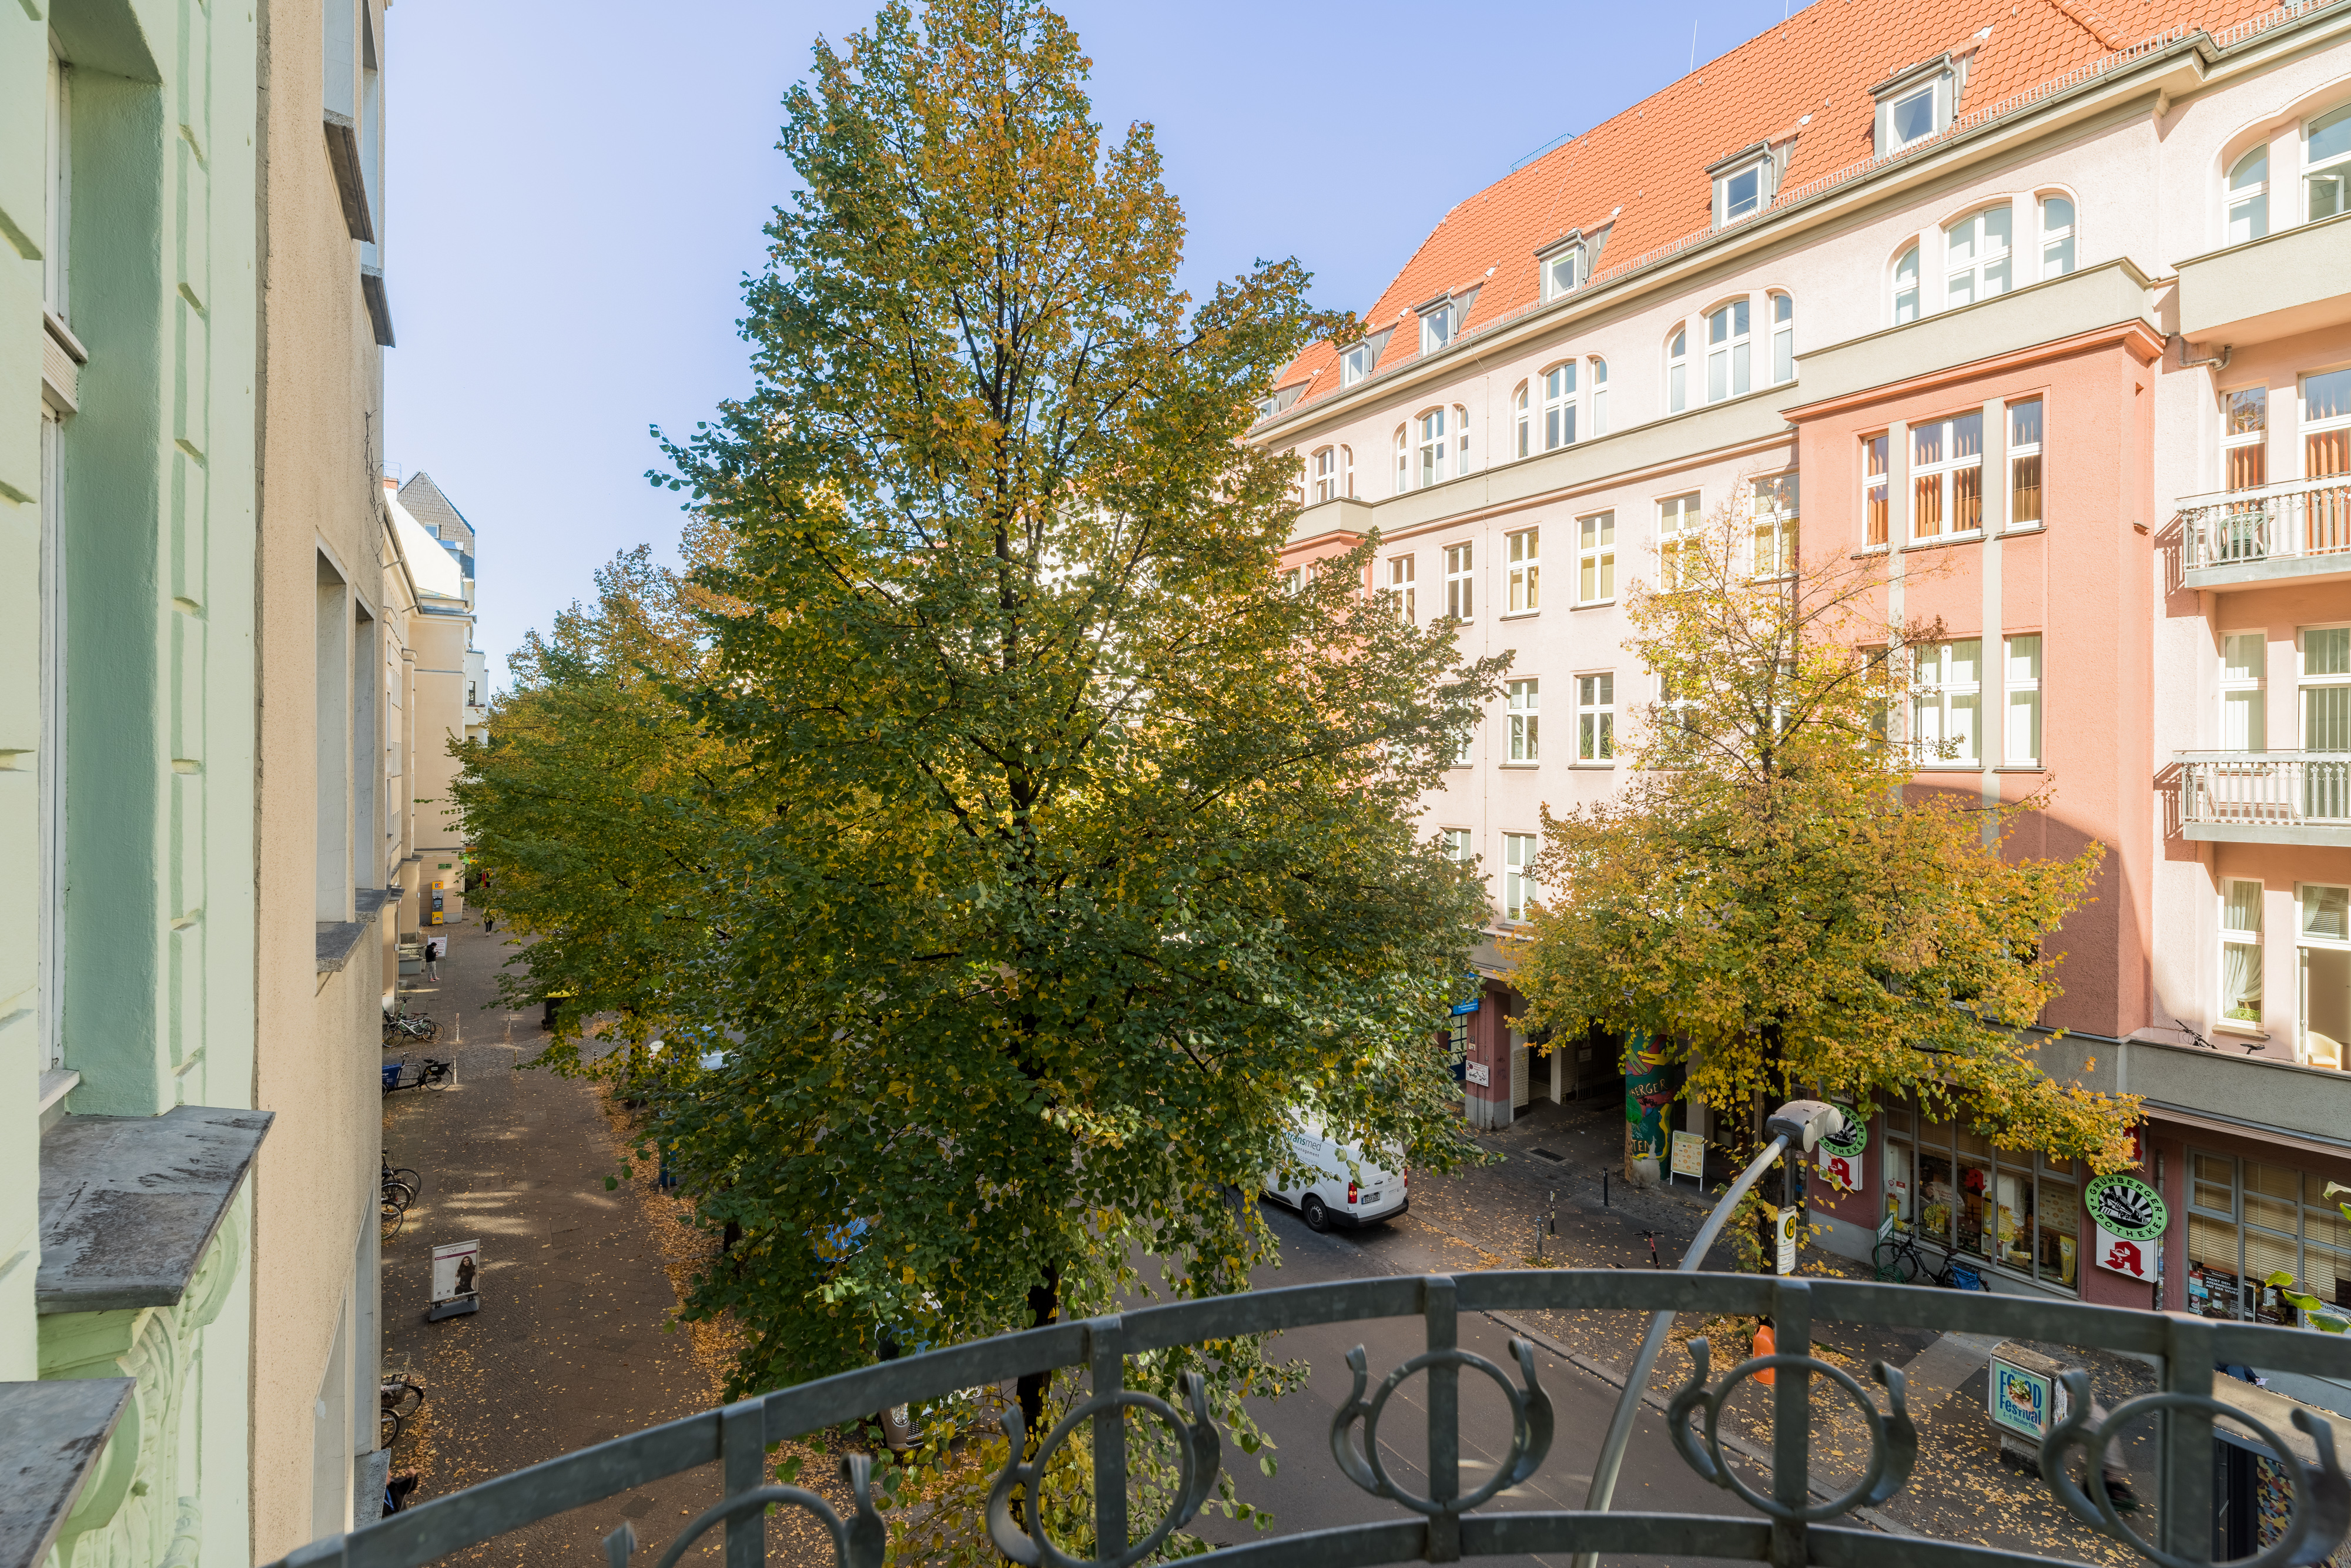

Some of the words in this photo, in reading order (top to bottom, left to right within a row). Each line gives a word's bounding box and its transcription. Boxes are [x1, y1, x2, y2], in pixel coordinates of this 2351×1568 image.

[1287, 1132, 1322, 1151] transmed
[1293, 1144, 1319, 1158] tmanagement
[1300, 1155, 1318, 1165] company
[2089, 1177, 2163, 1213] GRÜNBERGER
[1788, 1220, 1794, 1235] H
[2089, 1204, 2162, 1238] APOTHEKE
[2321, 1304, 2351, 1316] tungszei
[2000, 1393, 2041, 1426] Festival
[2014, 1416, 2029, 1427] Oktober
[2029, 1423, 2038, 1431] 2022
